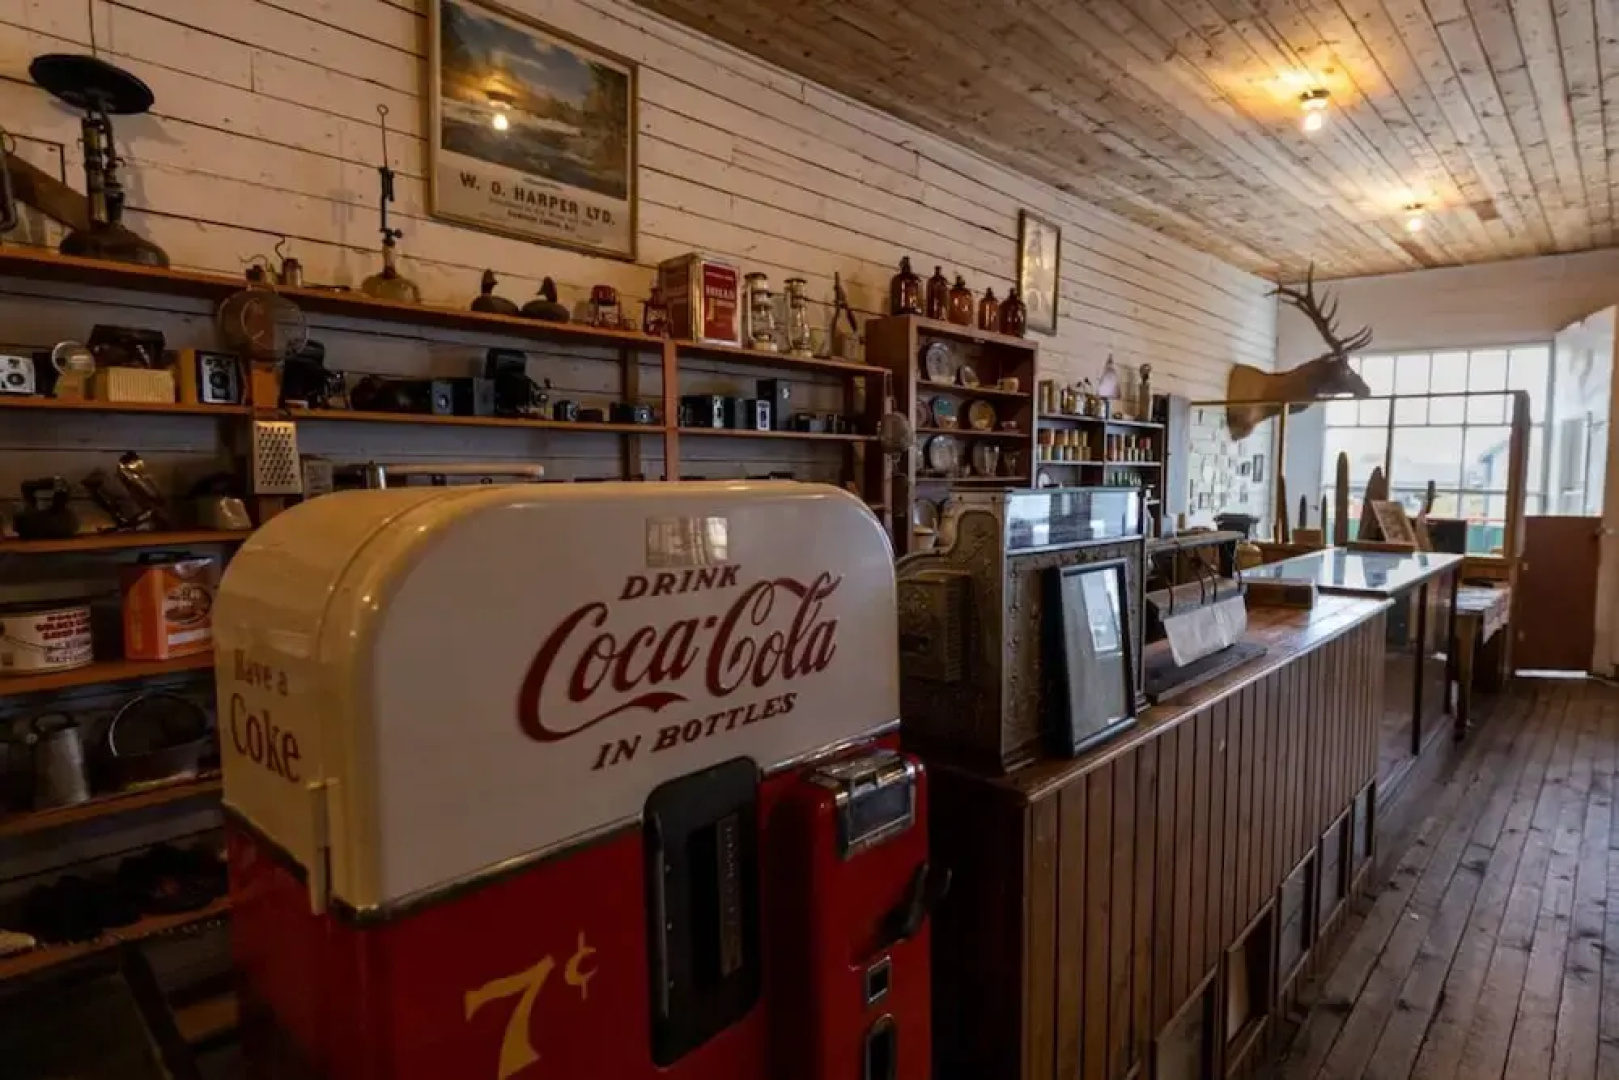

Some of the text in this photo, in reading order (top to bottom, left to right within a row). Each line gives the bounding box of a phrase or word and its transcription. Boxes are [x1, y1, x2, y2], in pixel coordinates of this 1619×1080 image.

[460, 170, 480, 191] W.
[514, 186, 579, 215] HARPER
[586, 205, 616, 227] LTD.
[619, 564, 741, 601] DRINK
[234, 649, 289, 697] Have a
[517, 571, 843, 743] Coca-Cola
[231, 692, 302, 783] Coke
[591, 692, 798, 772] IN BOTTLES
